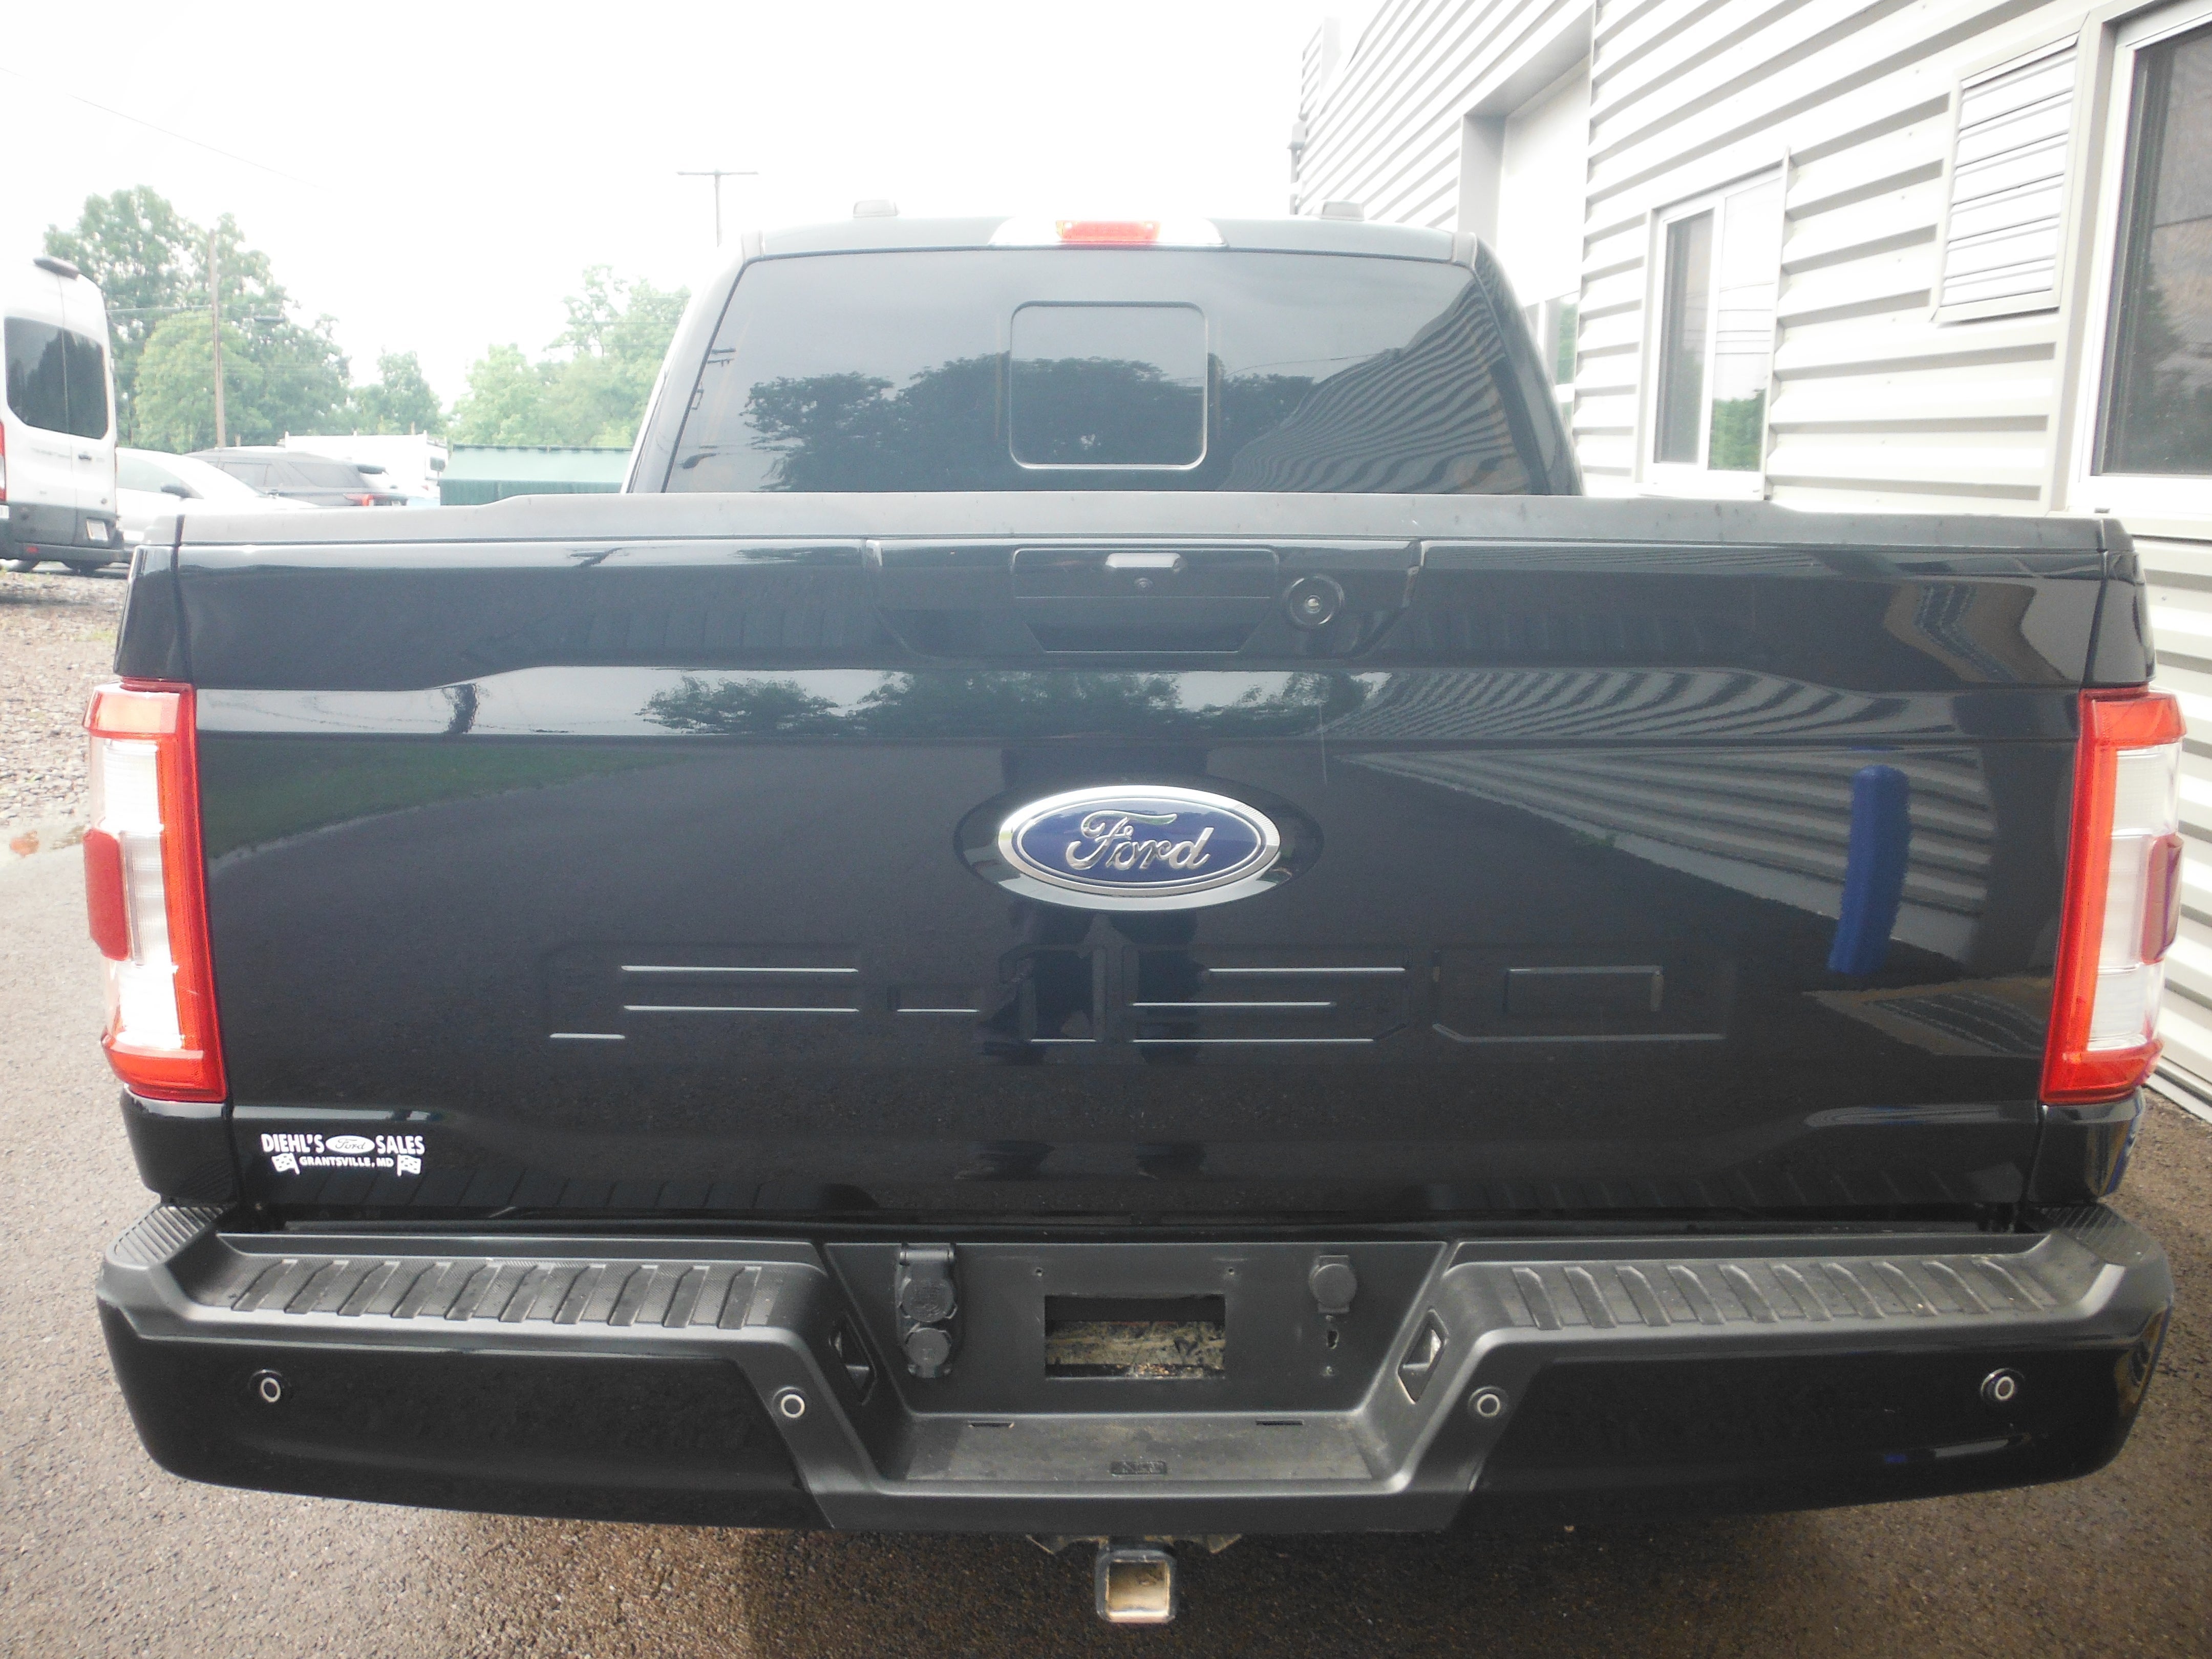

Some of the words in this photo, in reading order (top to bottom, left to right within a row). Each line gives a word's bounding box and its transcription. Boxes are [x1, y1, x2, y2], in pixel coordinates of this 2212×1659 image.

[1066, 809, 1215, 870] Ford
[261, 1133, 325, 1153] DIEHL'S
[335, 1138, 366, 1150] Ford
[375, 1135, 426, 1155] SALES
[299, 1156, 375, 1168] GRANTSVILLE,
[376, 1157, 394, 1167] MD
